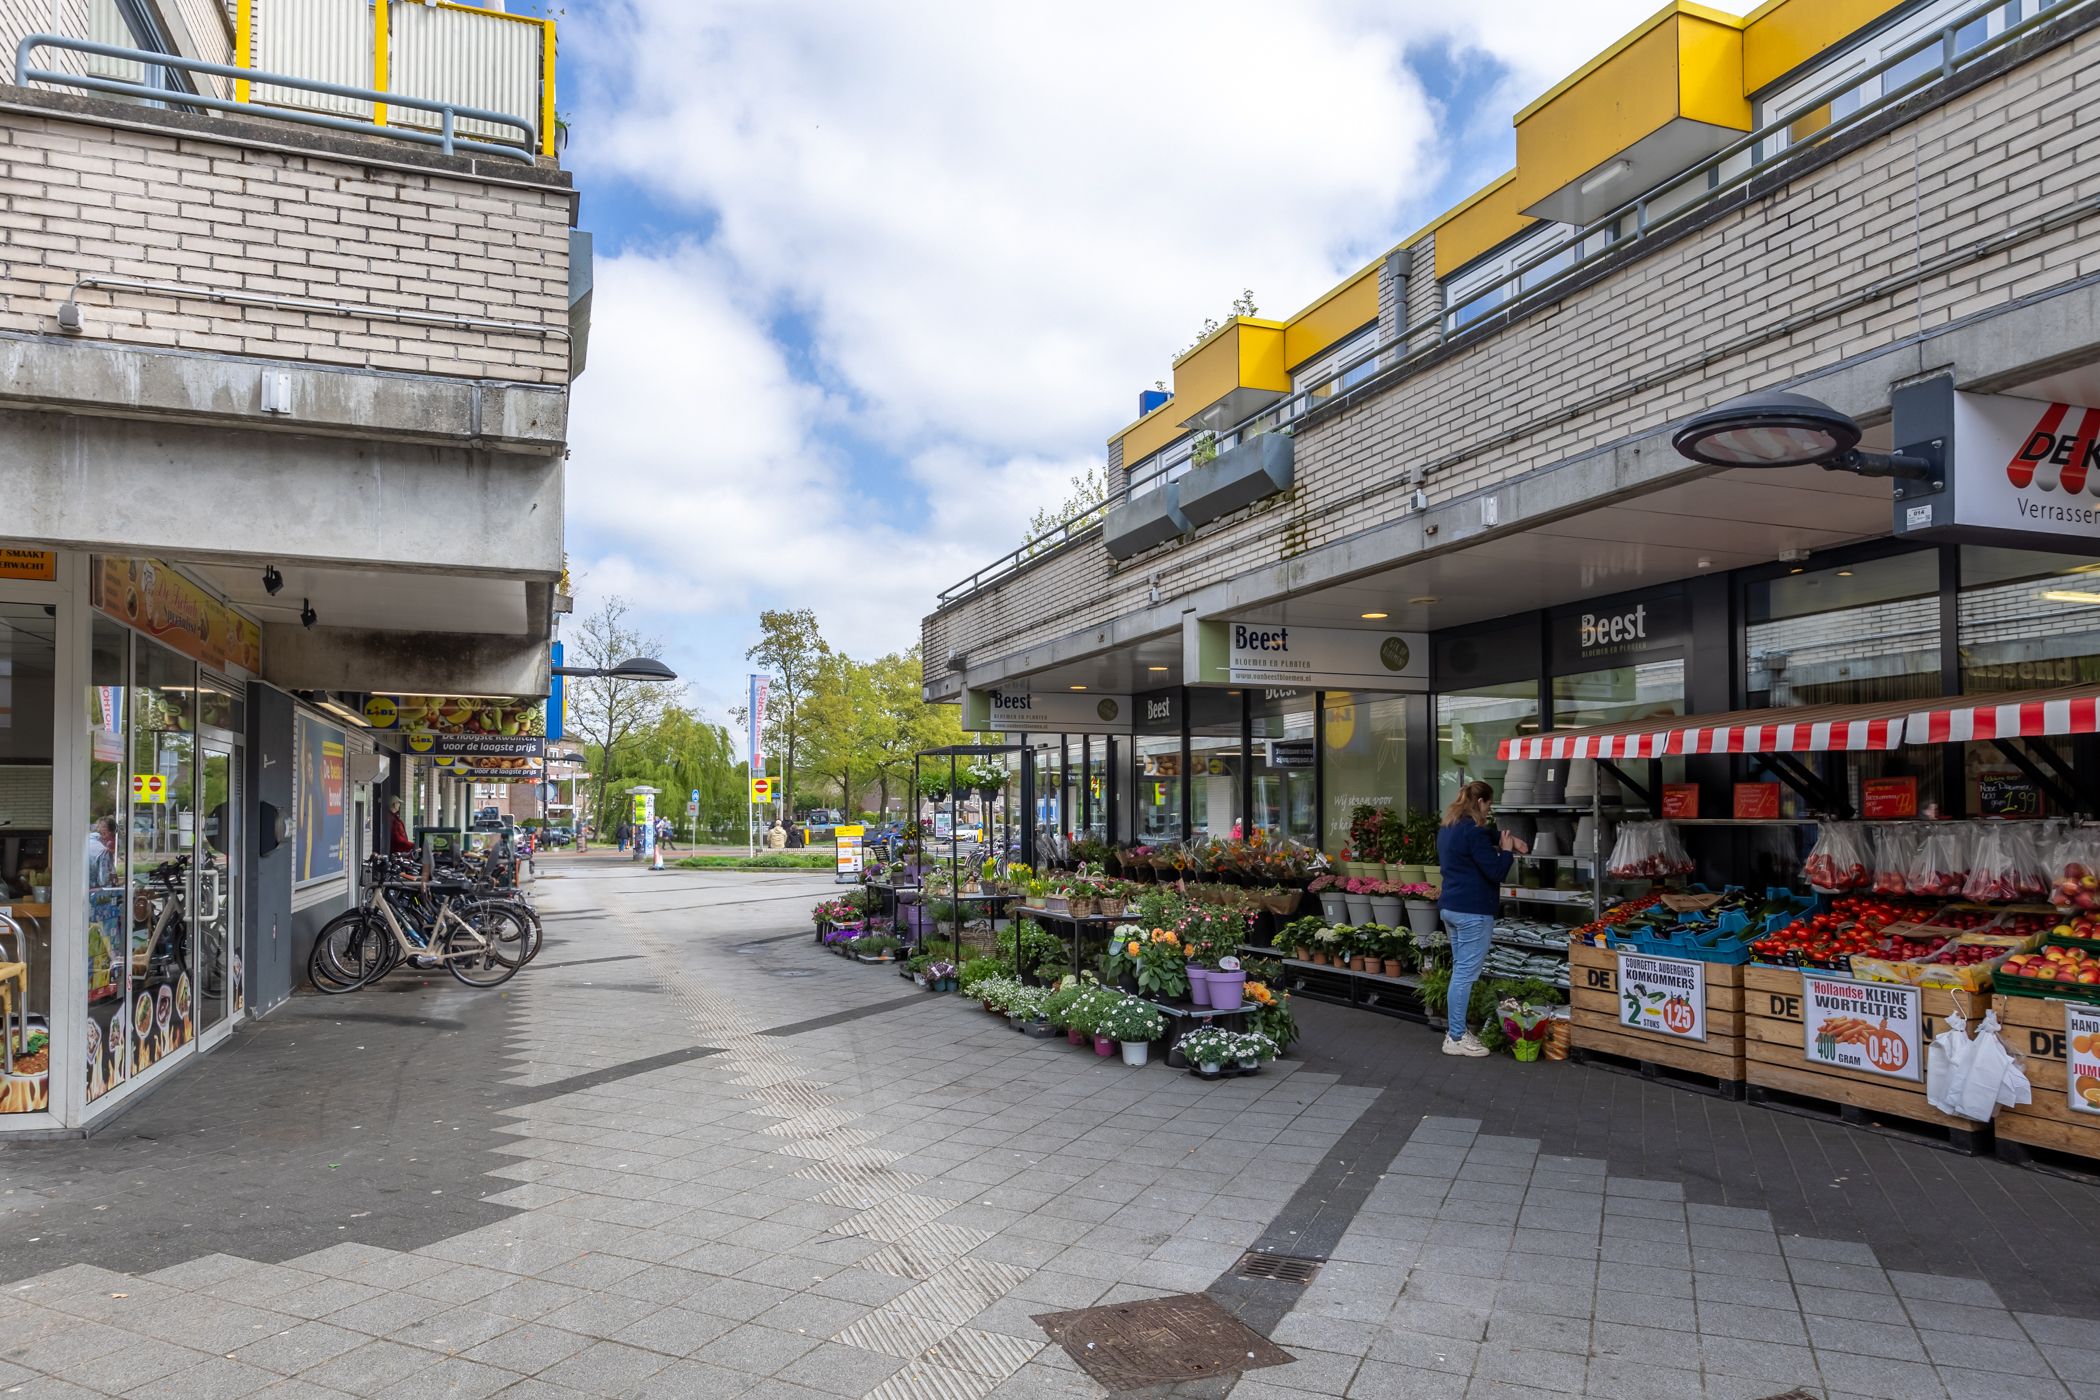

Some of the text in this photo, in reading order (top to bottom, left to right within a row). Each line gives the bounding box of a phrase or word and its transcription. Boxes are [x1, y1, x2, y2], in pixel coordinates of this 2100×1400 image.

[1581, 604, 1647, 647] Beest
[1235, 625, 1289, 652] Beest
[1235, 658, 1267, 667] BLOEMEN
[1281, 660, 1311, 669] PLANTEN
[995, 691, 1032, 709] Beest
[1147, 696, 1170, 719] Beest
[443, 742, 537, 753] voor de laagste prijs
[1588, 969, 1610, 990] DE
[1626, 968, 1695, 990] KOMKOMMERS
[1658, 963, 1694, 978] AUBERGINES
[1814, 981, 1907, 1006] Hollandse KLEINE
[1628, 999, 1692, 1029] 2 STUKS 1,25
[1770, 995, 1799, 1018] DE
[1815, 995, 1908, 1020] WORTELTJES
[1817, 1032, 1904, 1066] 400 GRAM 0,39
[2030, 1031, 2067, 1059] DE
